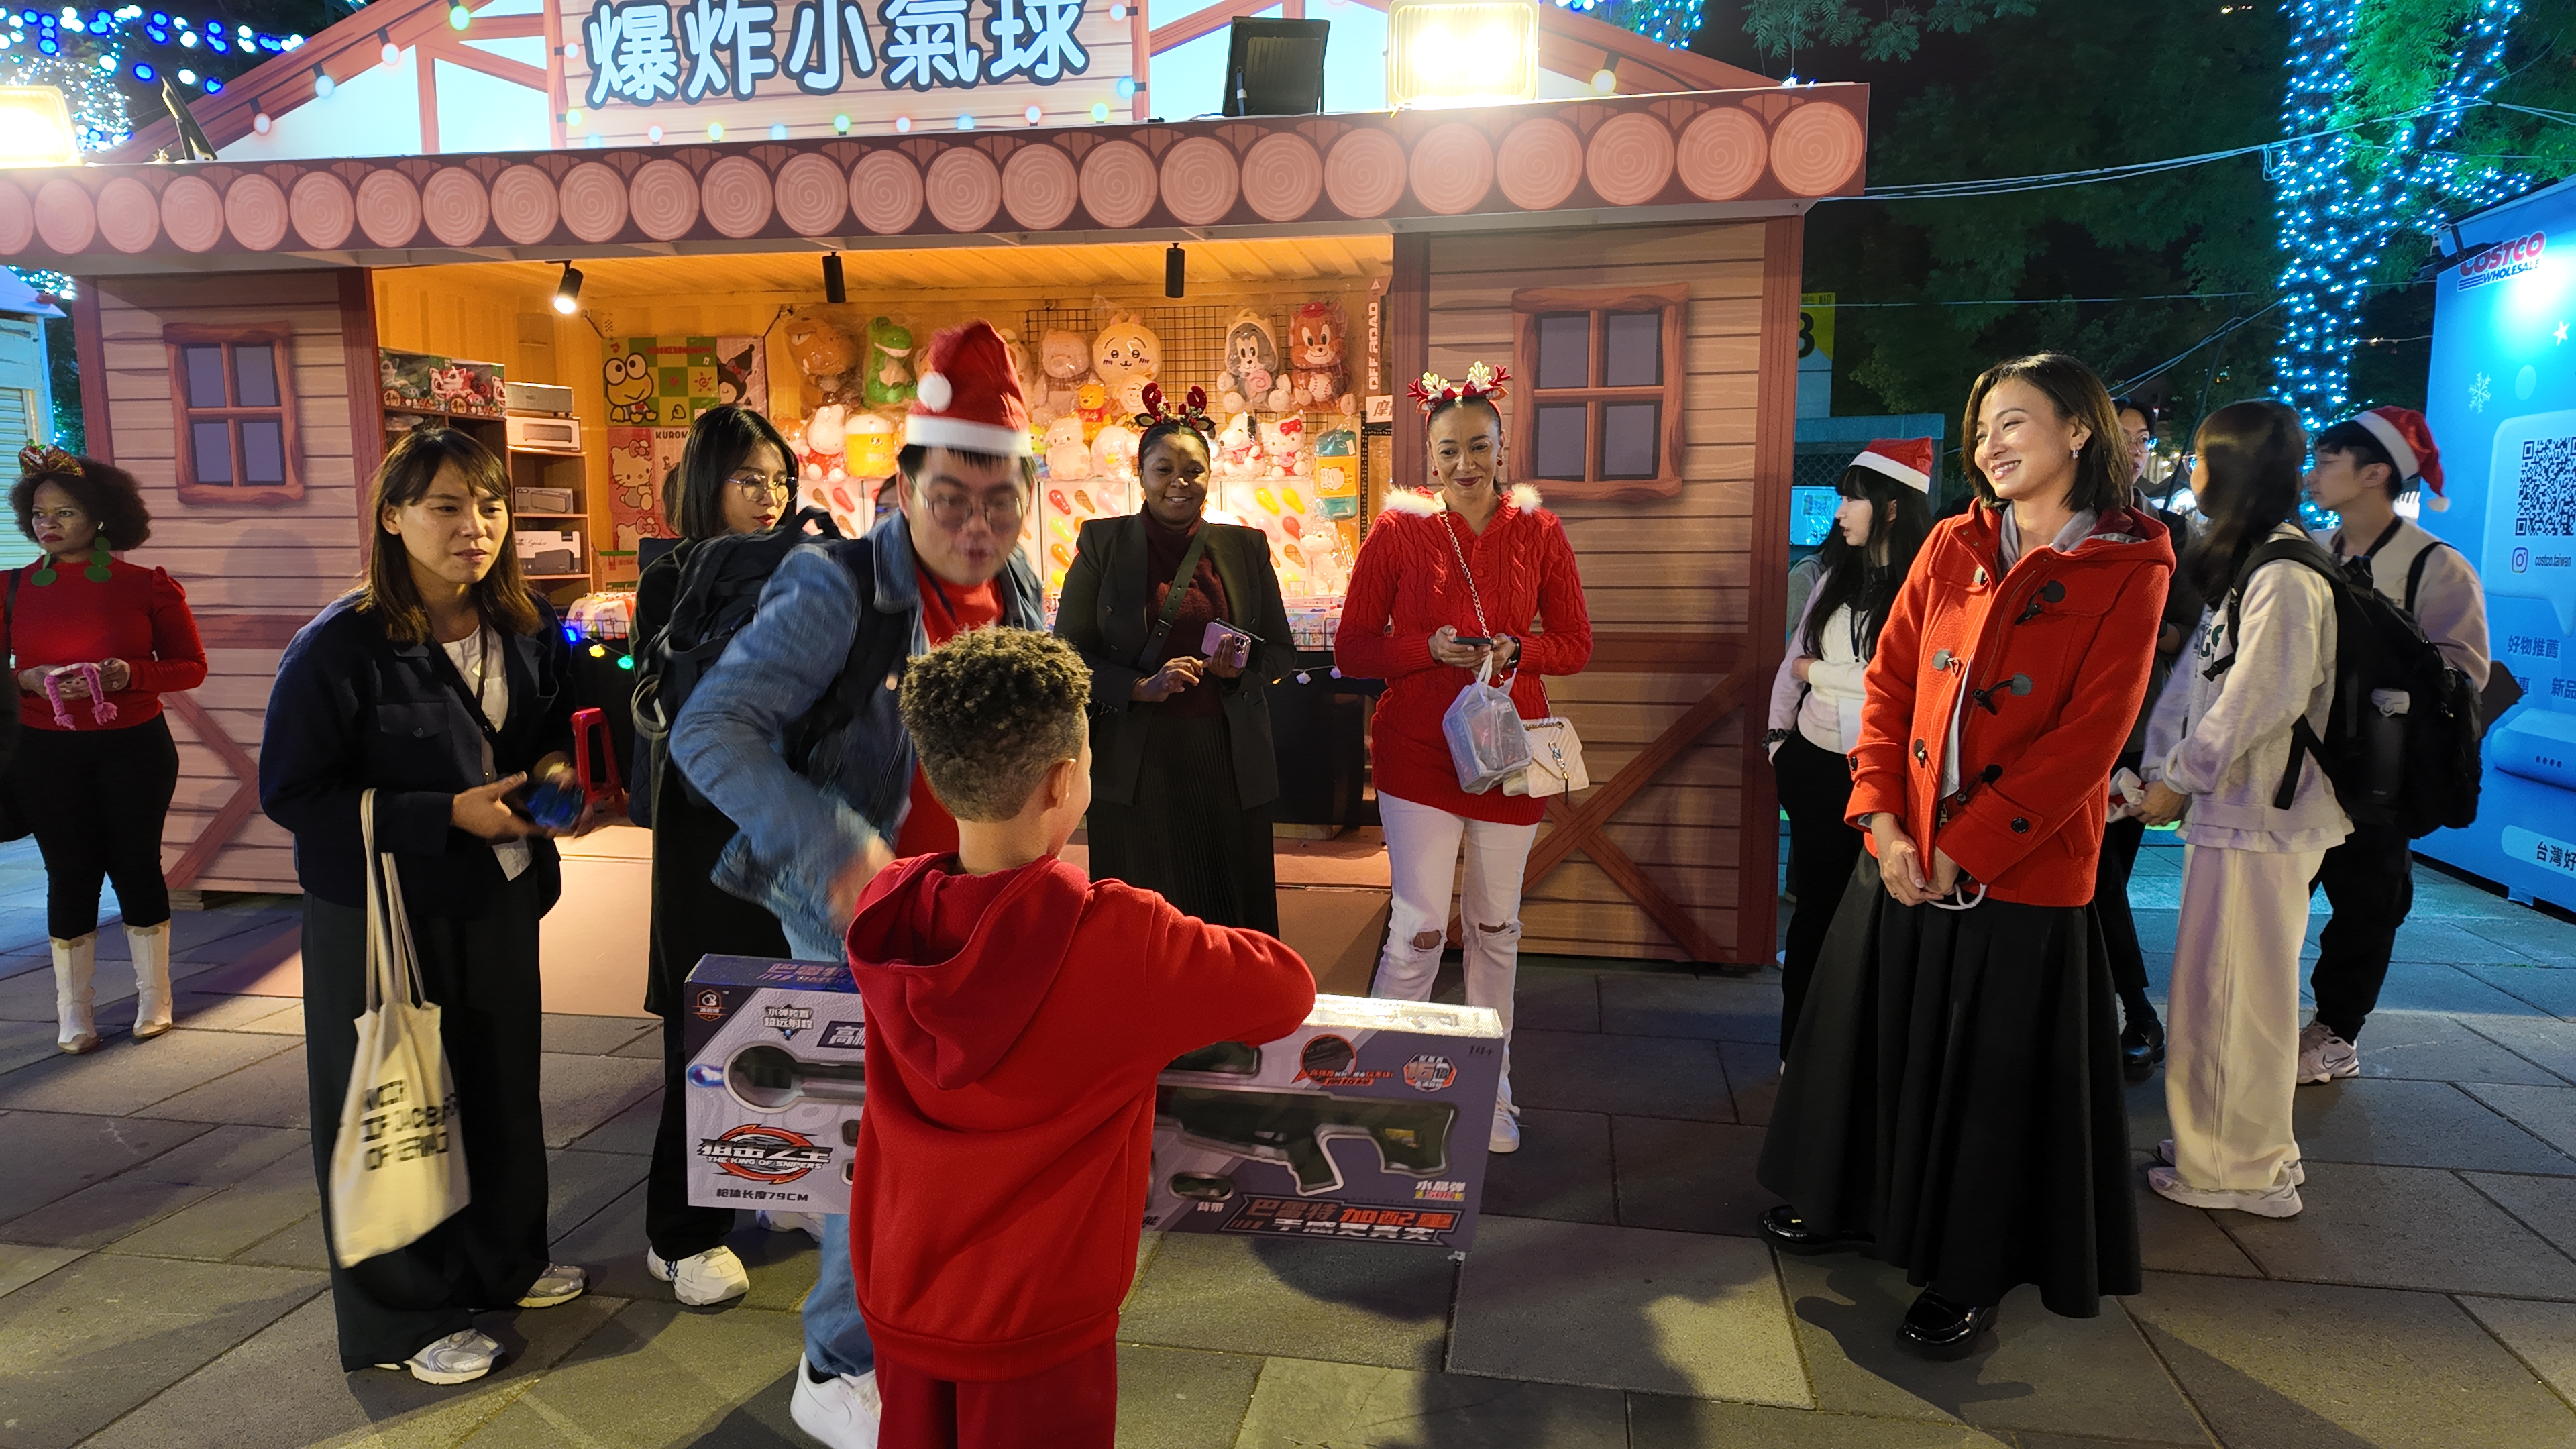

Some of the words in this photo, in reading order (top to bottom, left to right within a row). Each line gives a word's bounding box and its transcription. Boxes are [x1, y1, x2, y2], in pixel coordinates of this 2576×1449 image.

[586, 0, 1088, 106] 爆炸小氣球
[2460, 232, 2545, 276] COSTCO
[2483, 259, 2540, 283] WHOLESALE
[1368, 356, 1378, 390] OFF
[2534, 553, 2571, 567] costco.taiwan
[2508, 635, 2559, 659] 好物推薦
[2551, 677, 2576, 699] 新品
[2536, 841, 2576, 871] 台灣好
[699, 1139, 831, 1163] 狙击之王
[776, 1161, 824, 1170] SNIPERS
[1415, 1180, 1466, 1193] 水晶弹
[1246, 1199, 1338, 1220] 巴雷特
[1338, 1208, 1454, 1229] 加配重
[1272, 1218, 1435, 1241] 手感更真实
